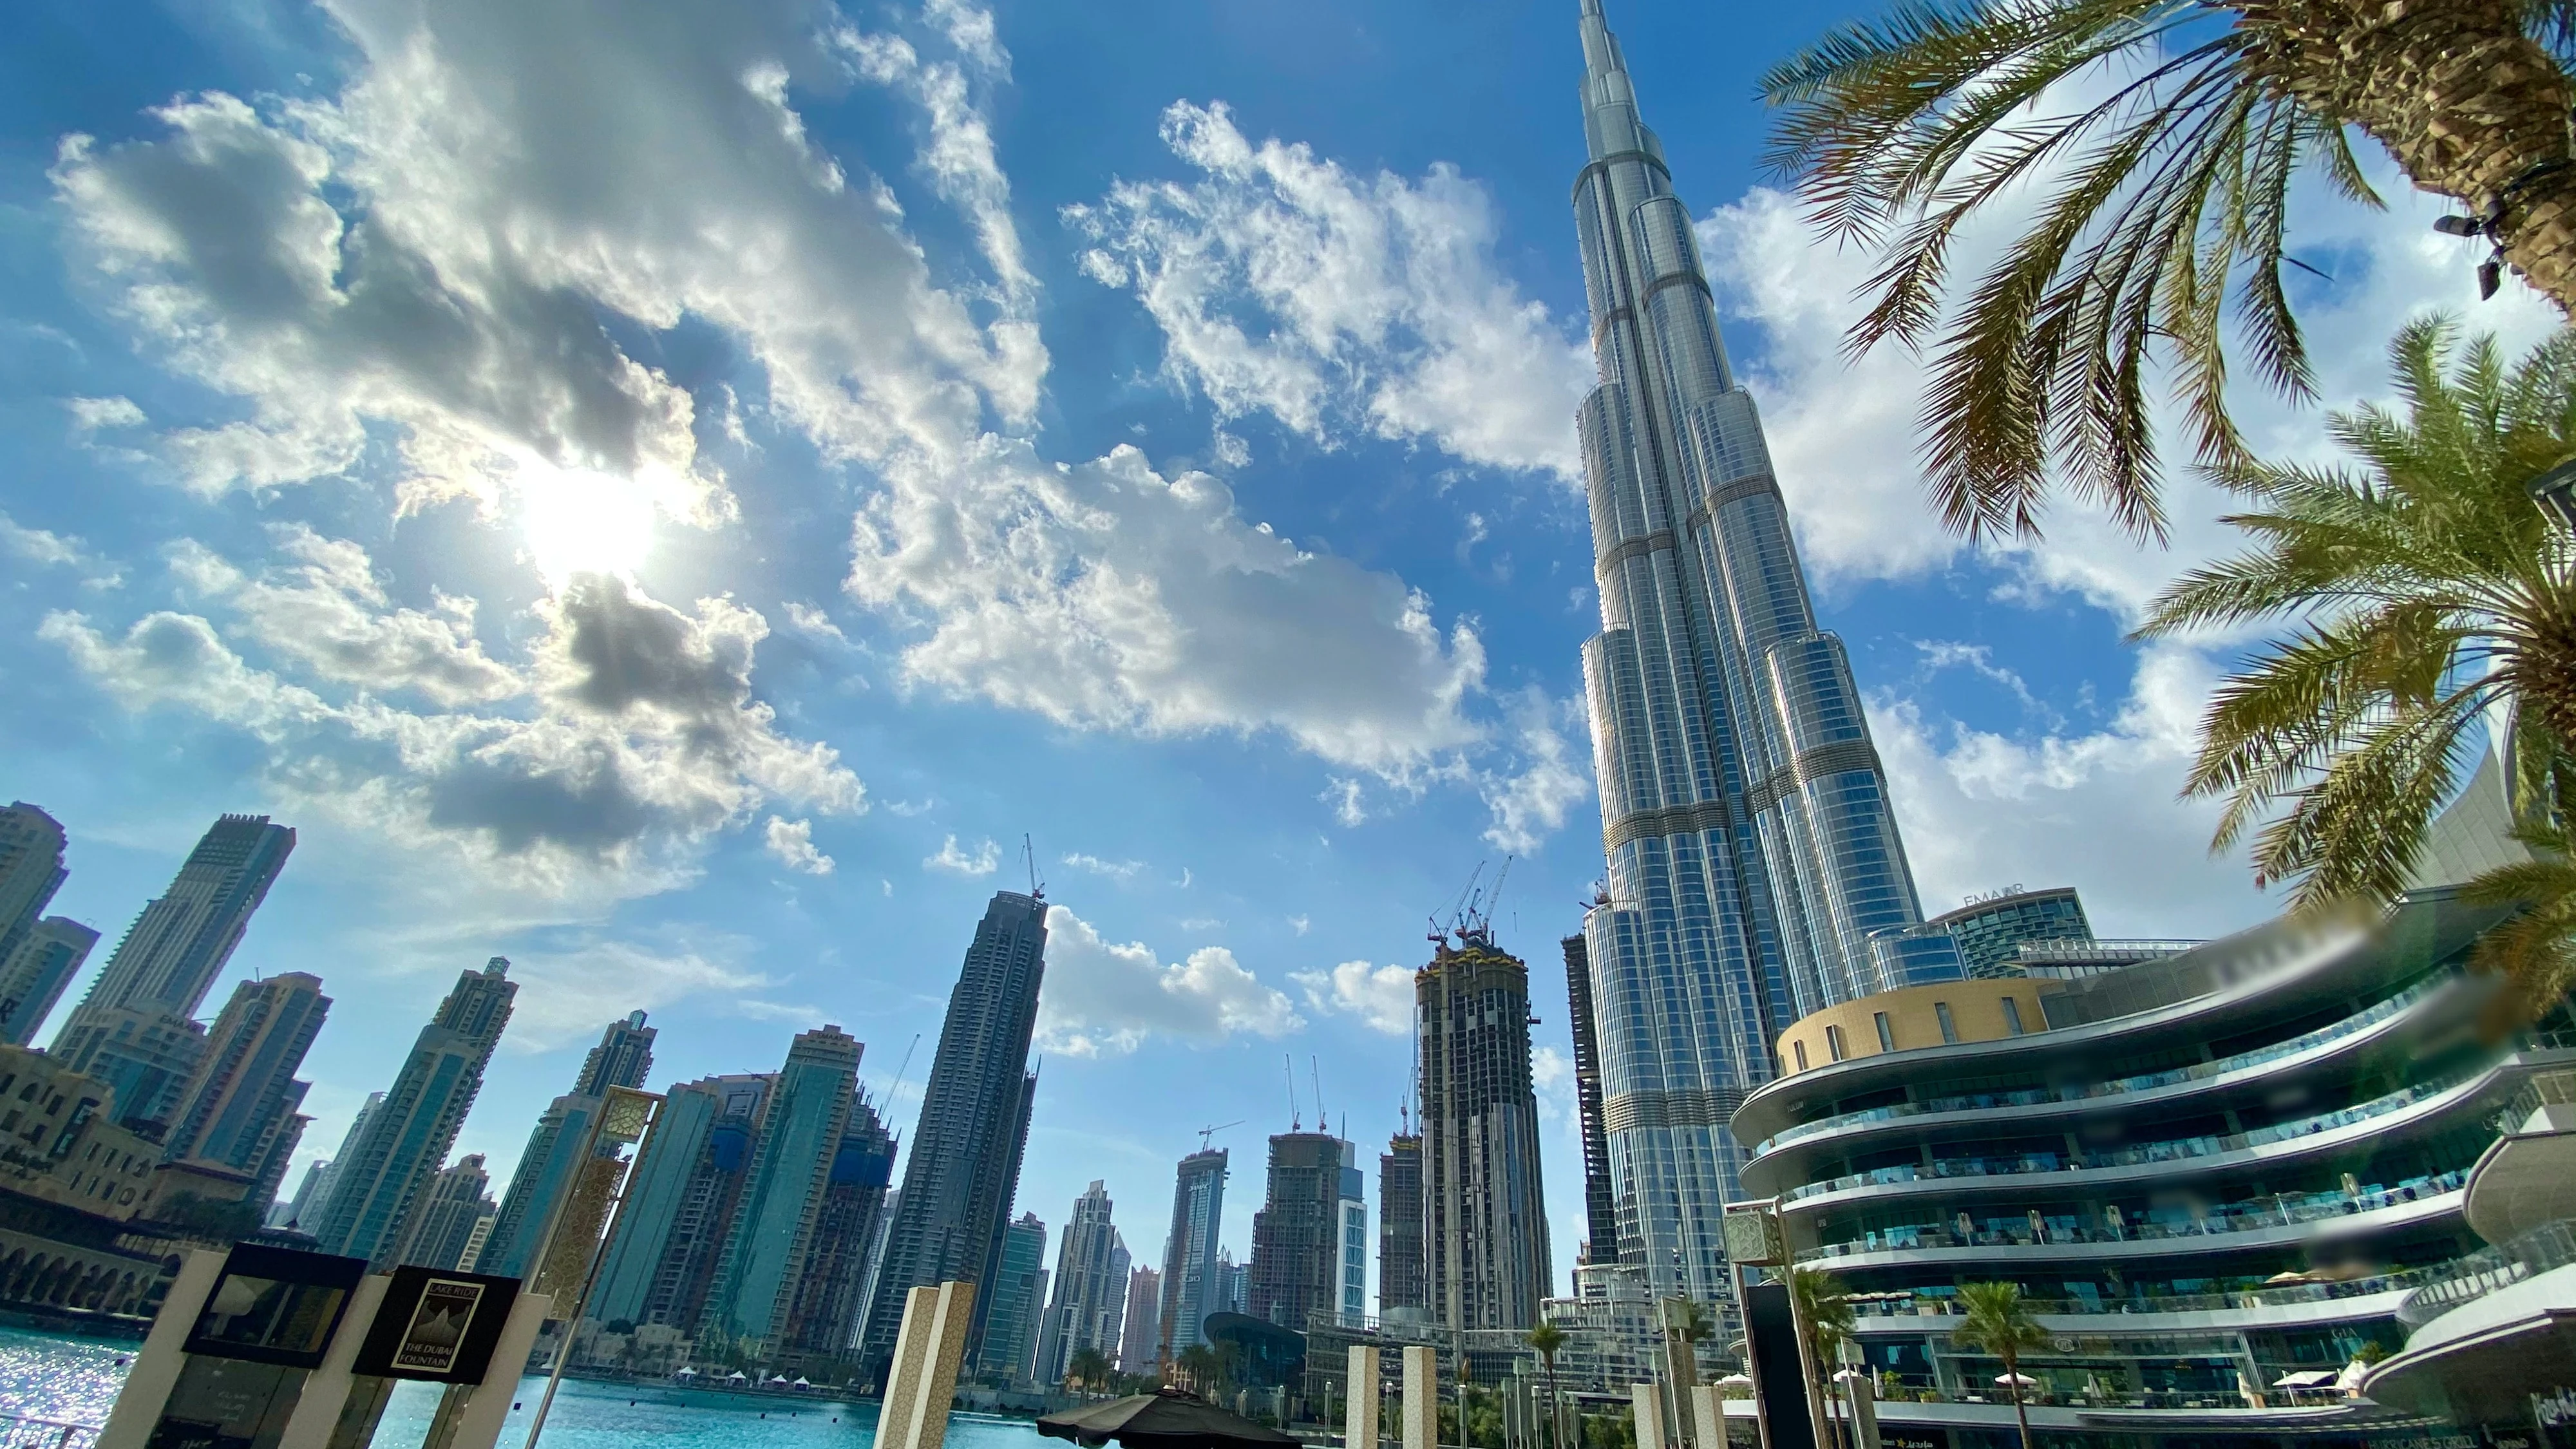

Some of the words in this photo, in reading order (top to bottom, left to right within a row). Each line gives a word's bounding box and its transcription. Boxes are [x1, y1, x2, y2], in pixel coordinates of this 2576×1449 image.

[1963, 883, 2027, 907] EMAAR
[430, 1284, 453, 1294] LAKE
[453, 1287, 478, 1297] RIDE
[405, 1343, 422, 1353] THE
[423, 1345, 454, 1356] DUBAI
[399, 1354, 449, 1367] FOUNTAIN
